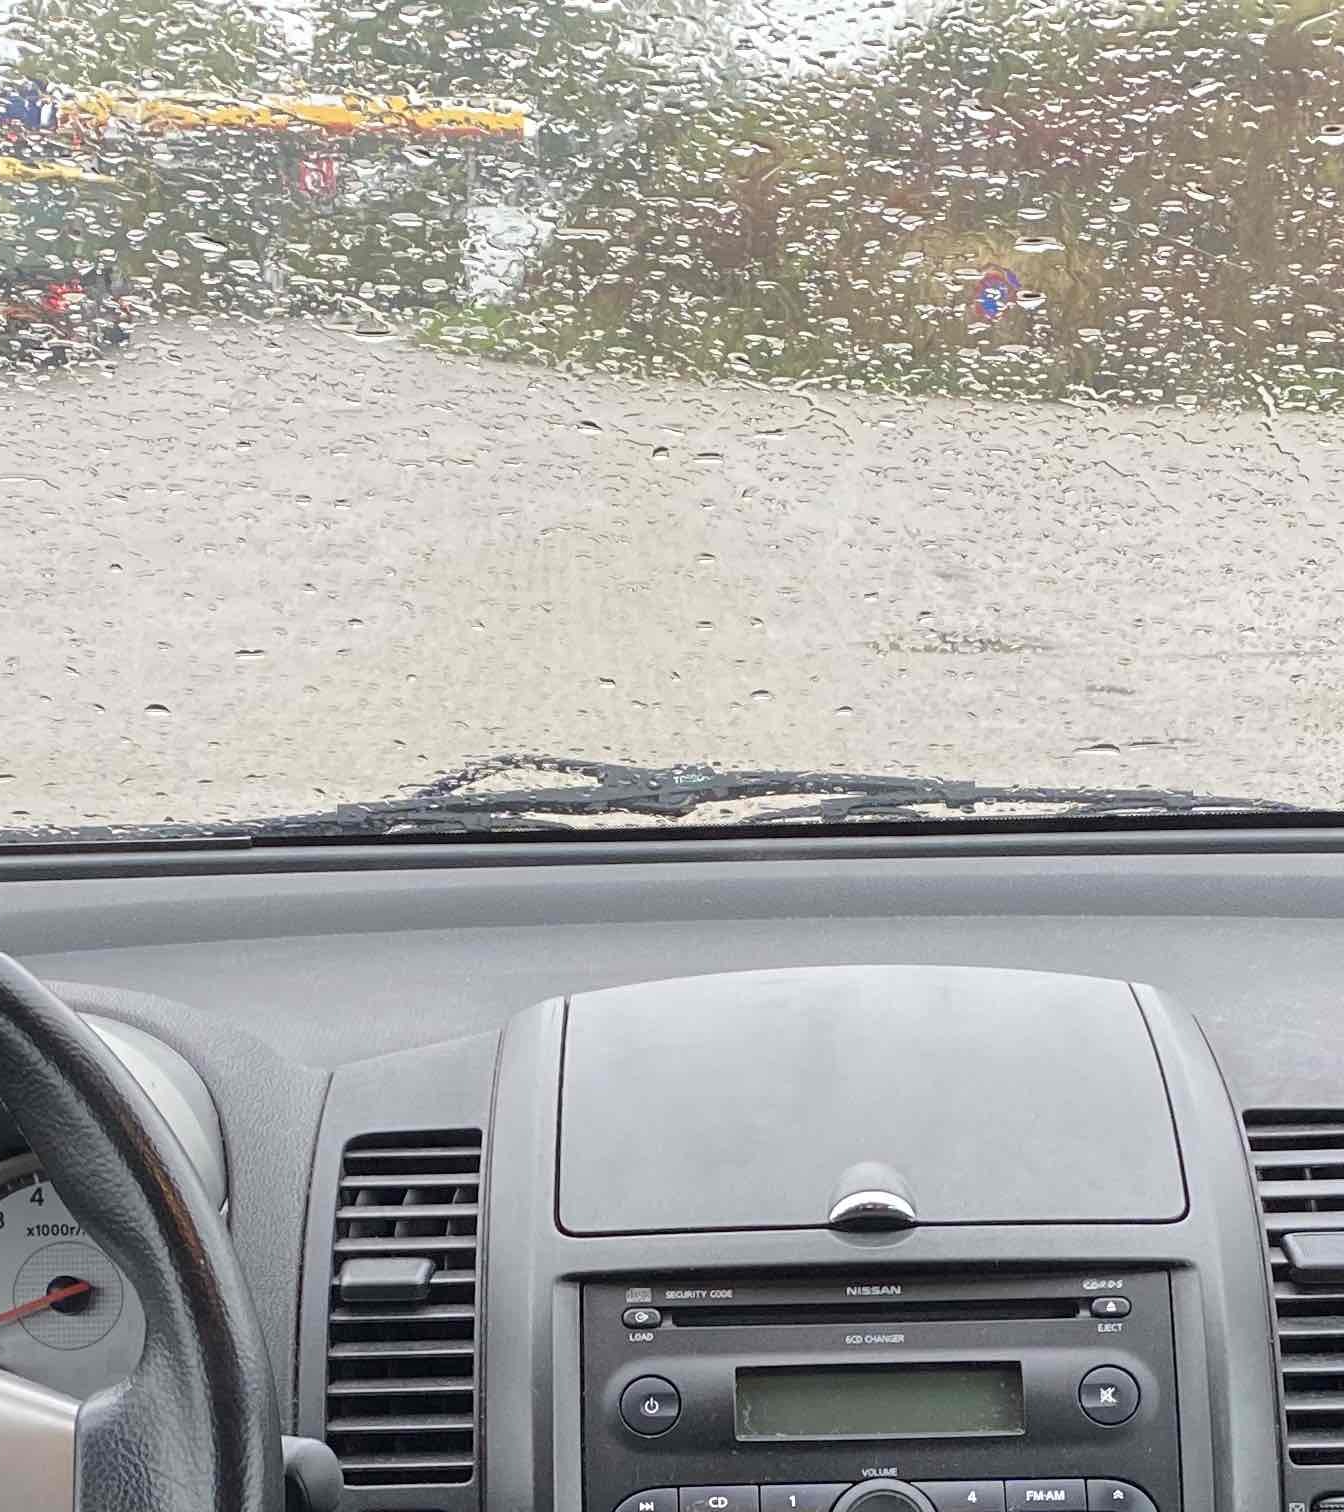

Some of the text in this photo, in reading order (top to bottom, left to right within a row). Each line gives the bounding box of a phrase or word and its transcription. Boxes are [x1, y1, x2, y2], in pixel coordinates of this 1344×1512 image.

[30, 1187, 44, 1206] 4
[665, 1289, 733, 1300] SECURITY CODE
[846, 1286, 902, 1297] NISSAN
[1097, 1323, 1123, 1333] EJECT
[629, 1332, 654, 1342] LOAD
[845, 1334, 904, 1345] 6CD CHANGER
[862, 1468, 898, 1477] VOLUME
[708, 1496, 728, 1509] CD
[788, 1495, 796, 1507] 1
[967, 1491, 977, 1503] 4
